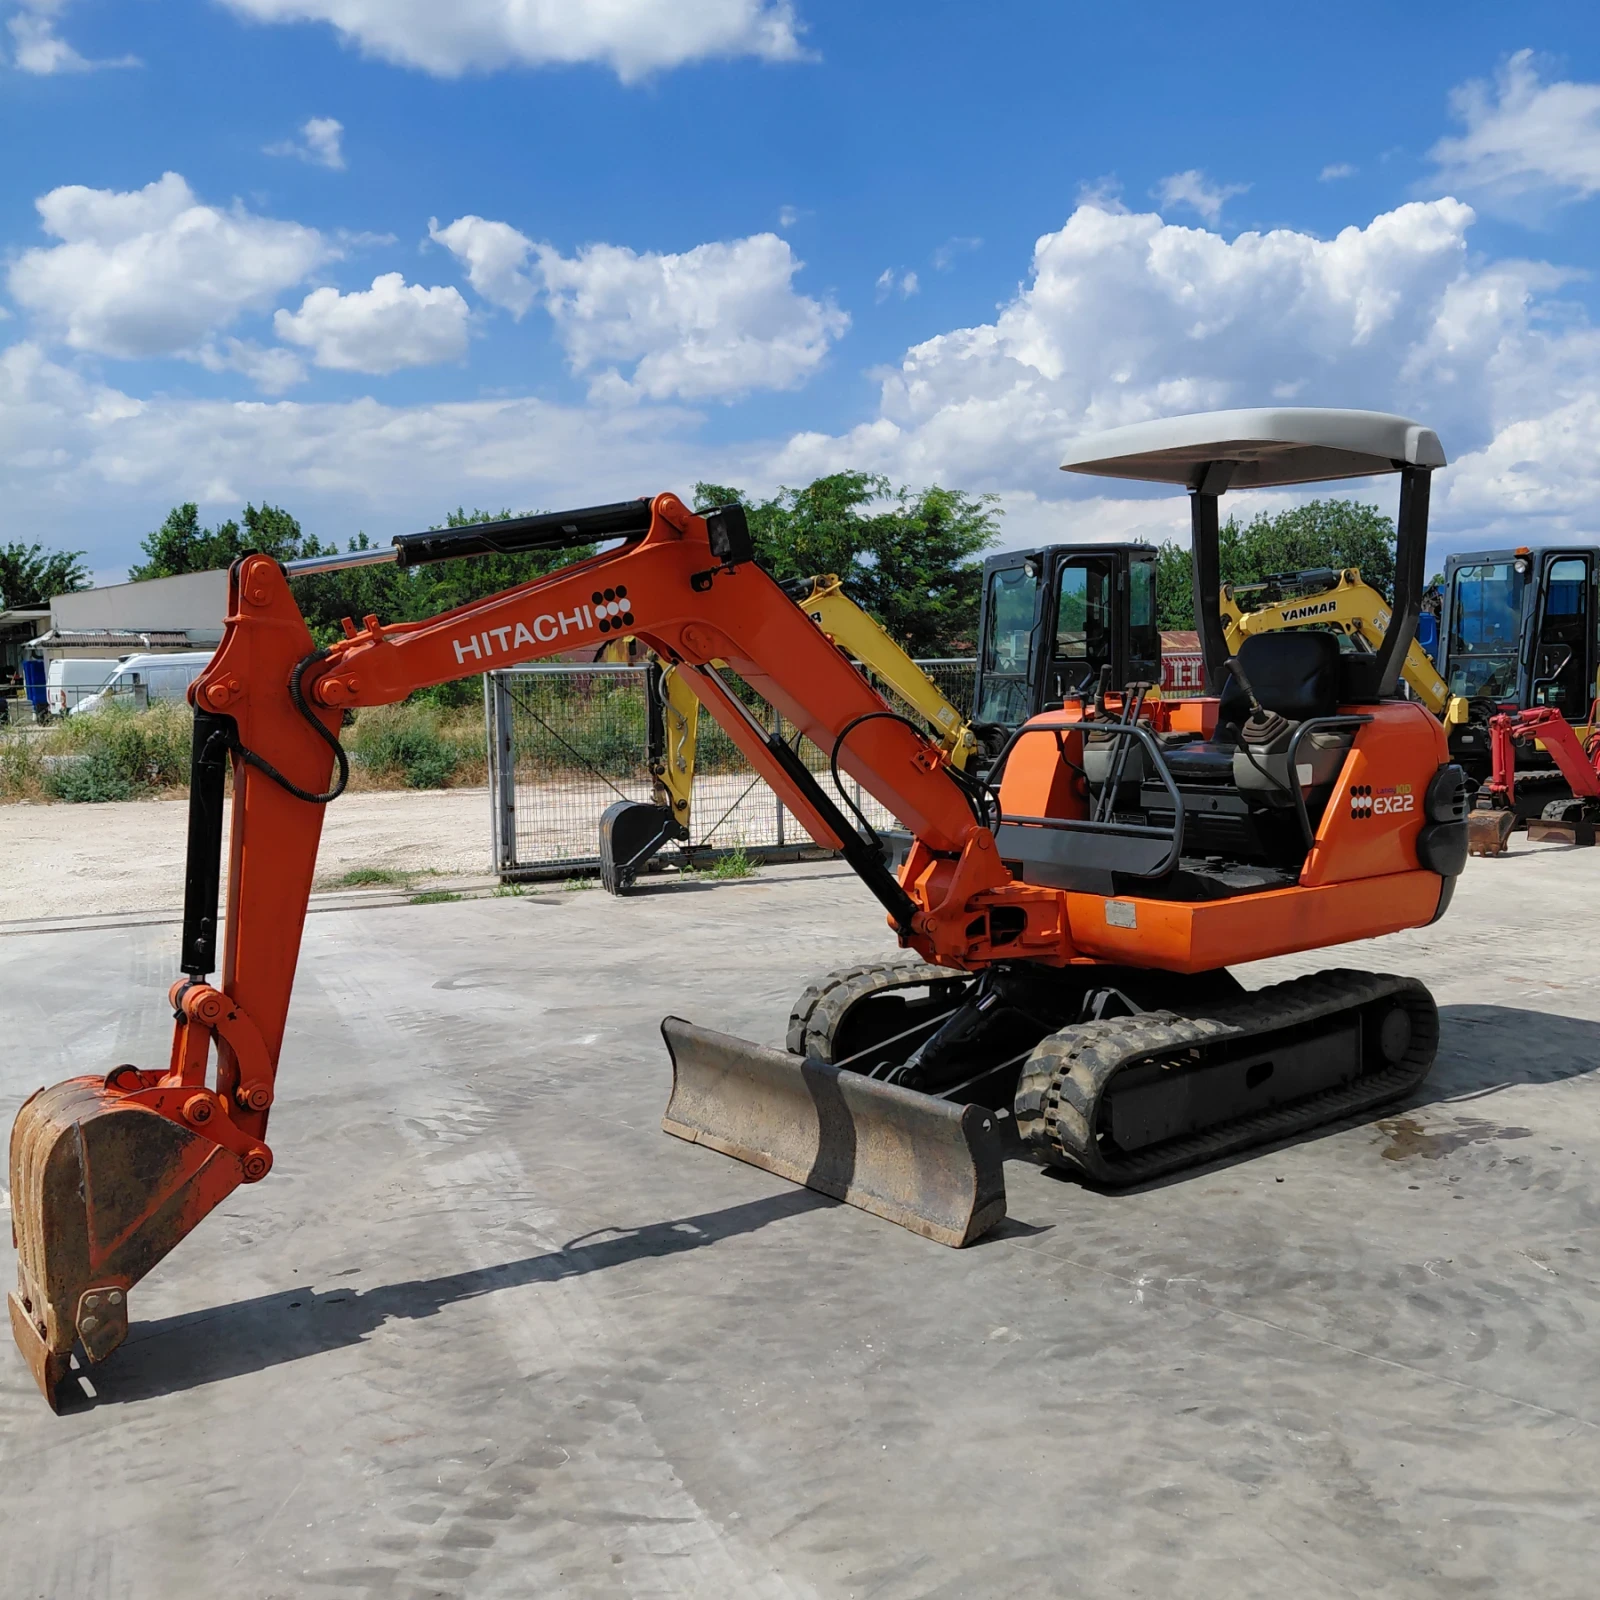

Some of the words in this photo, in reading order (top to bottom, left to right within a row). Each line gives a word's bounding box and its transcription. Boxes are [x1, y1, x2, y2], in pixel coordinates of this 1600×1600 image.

[1281, 601, 1337, 621] YANMAR
[452, 605, 593, 664] HITACHI
[1373, 794, 1414, 815] EX22
